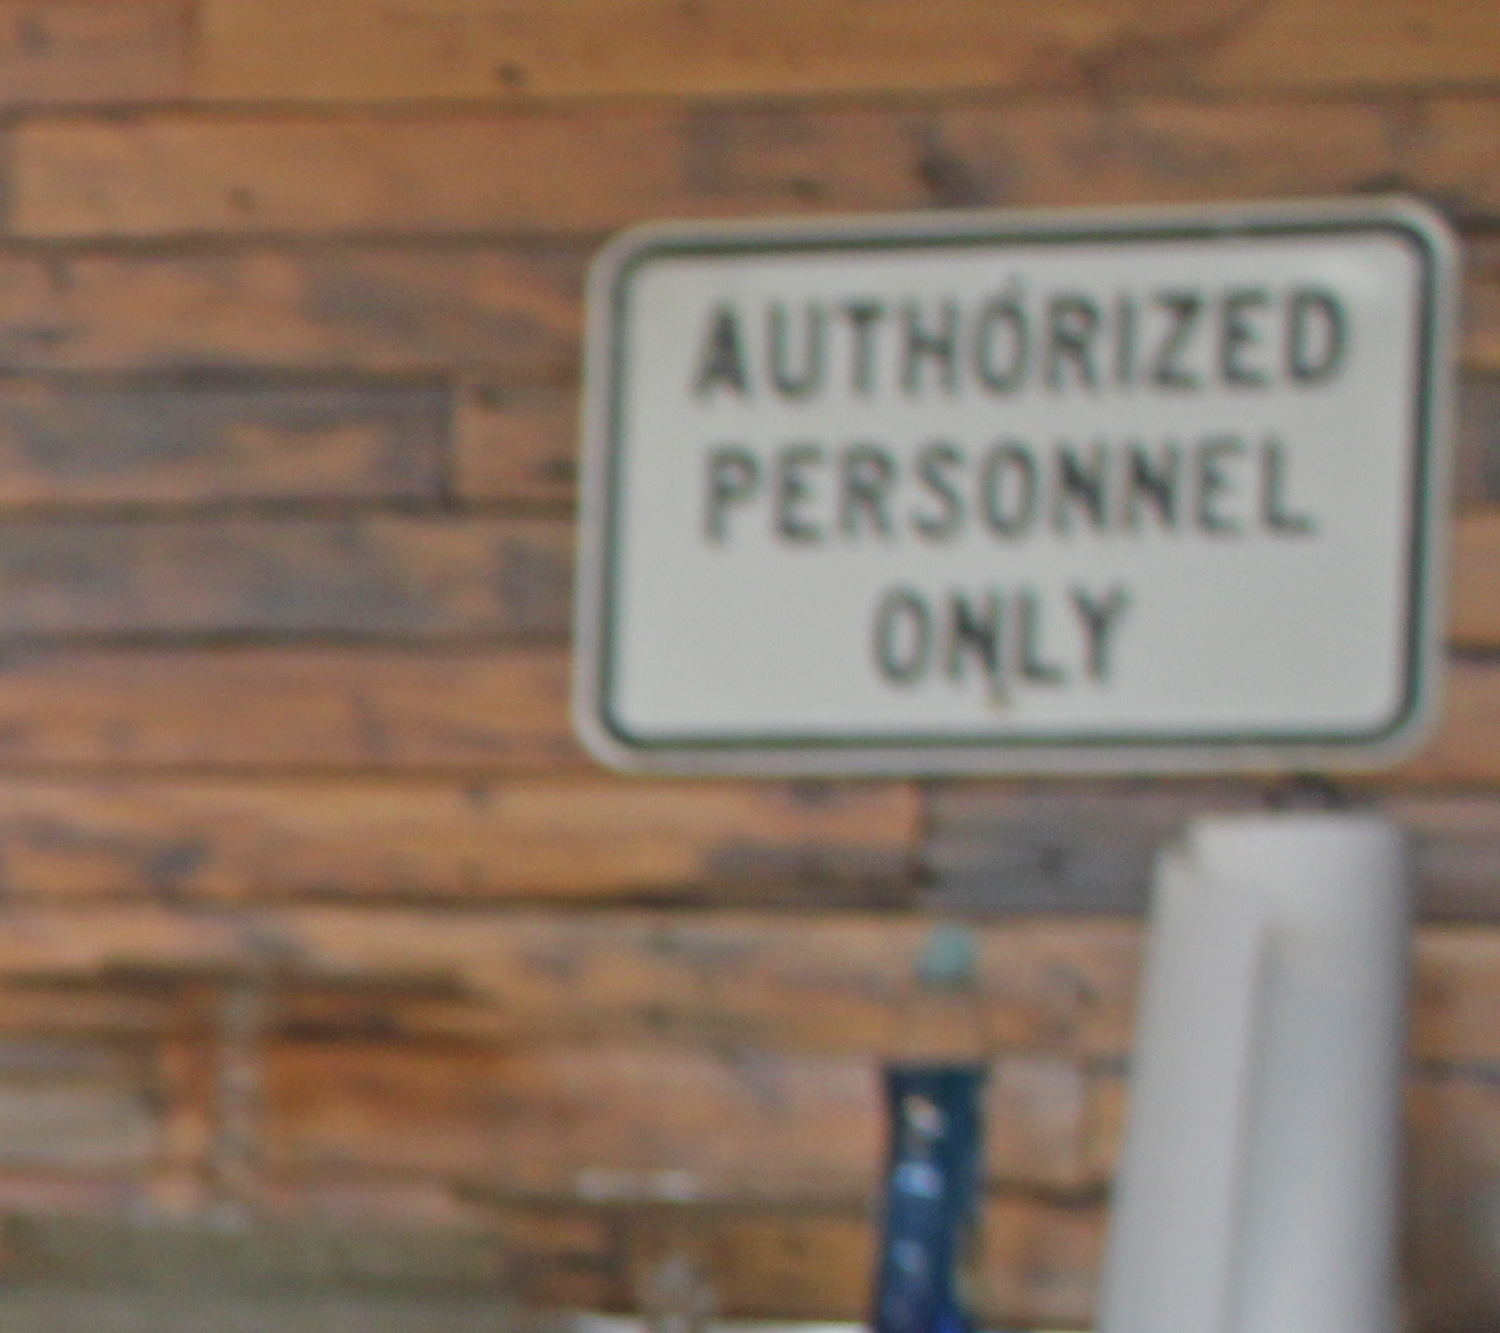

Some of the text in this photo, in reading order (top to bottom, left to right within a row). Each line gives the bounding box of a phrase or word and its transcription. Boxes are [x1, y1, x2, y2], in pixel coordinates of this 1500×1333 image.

[693, 282, 1350, 402] AUTHORIZED
[700, 435, 1318, 547] PERSONNEL
[872, 585, 1130, 690] ONLY
